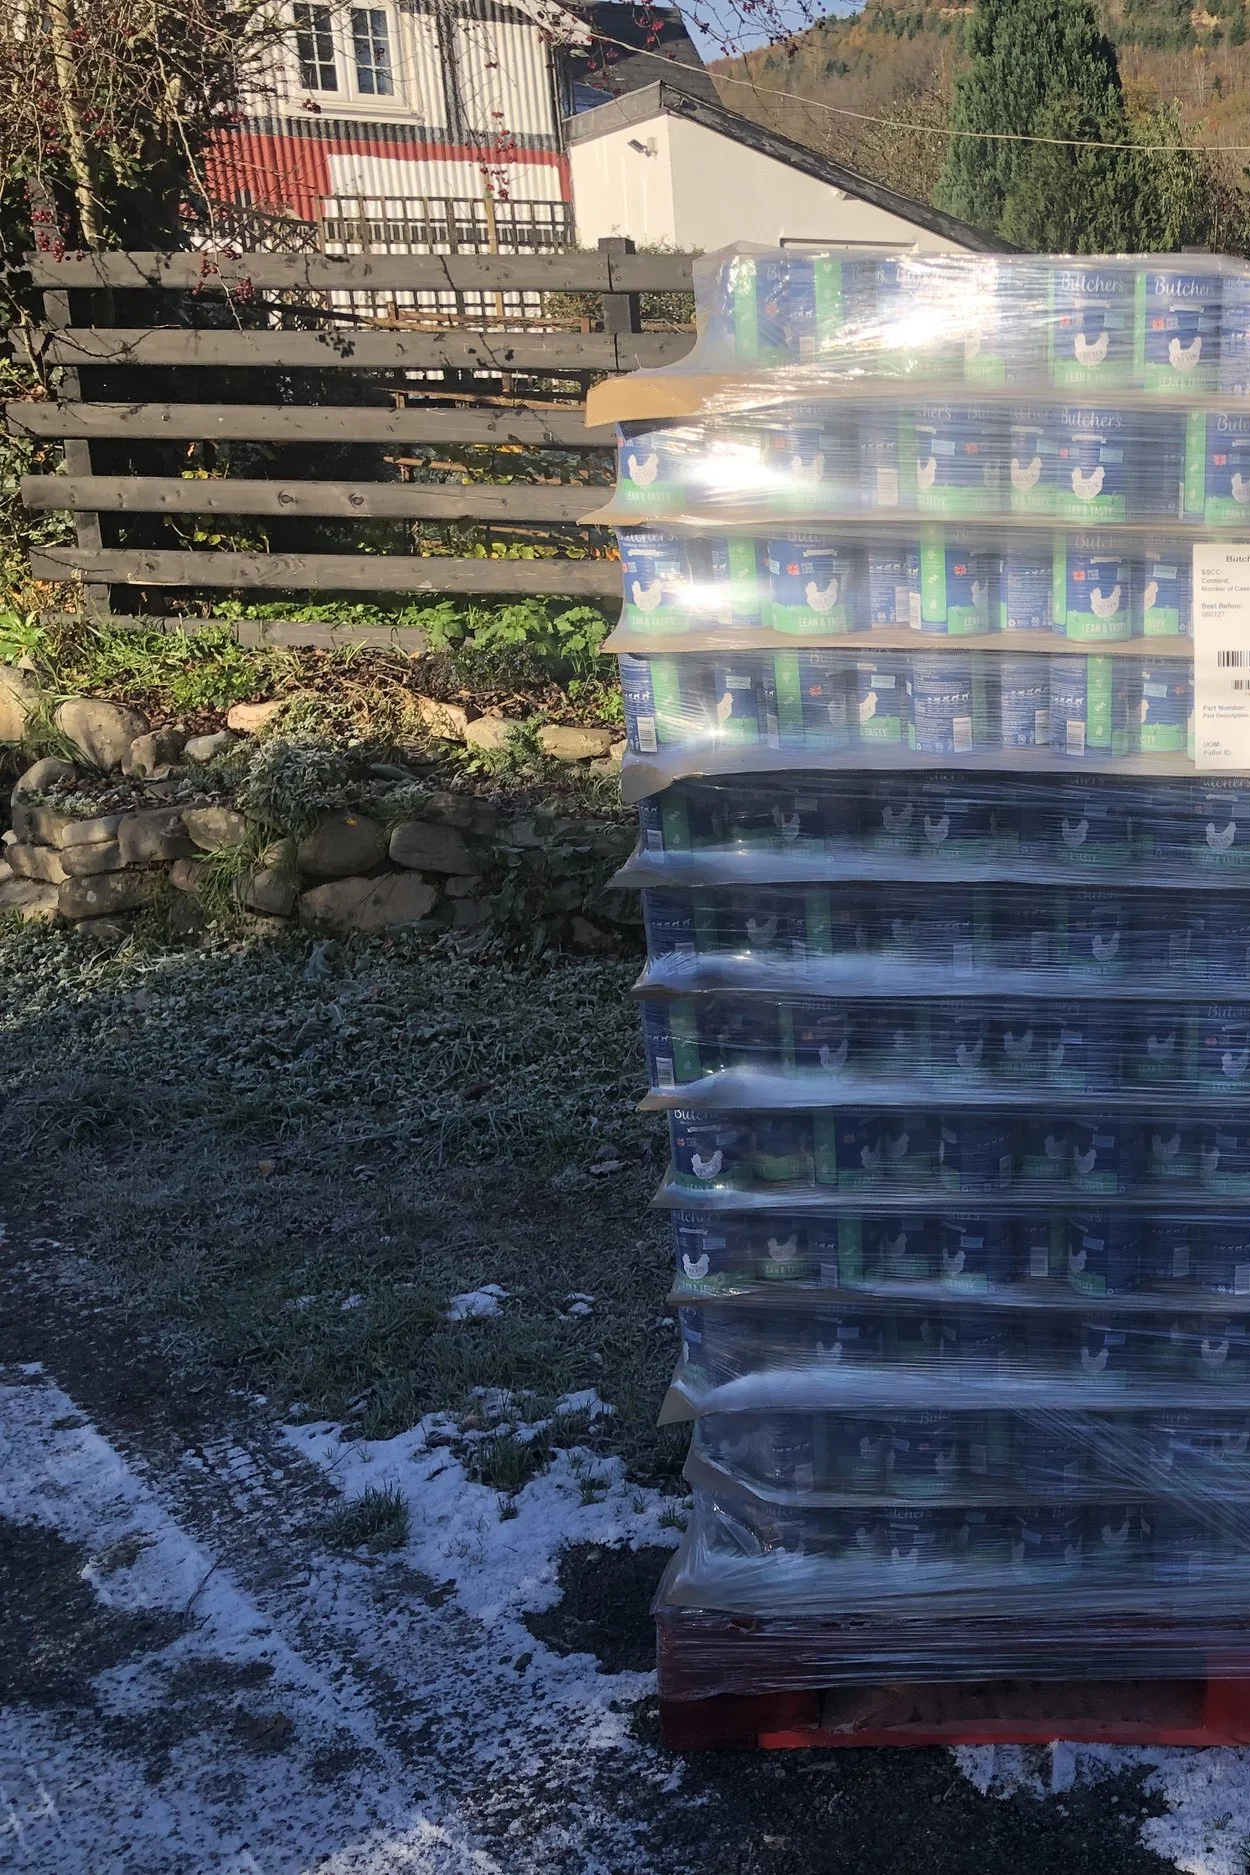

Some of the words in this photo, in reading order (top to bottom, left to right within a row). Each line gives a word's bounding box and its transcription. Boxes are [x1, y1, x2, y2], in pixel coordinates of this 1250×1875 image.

[1089, 505, 1113, 516] TASTY
[799, 616, 816, 628] LEAN
[1081, 623, 1100, 633] LEAN
